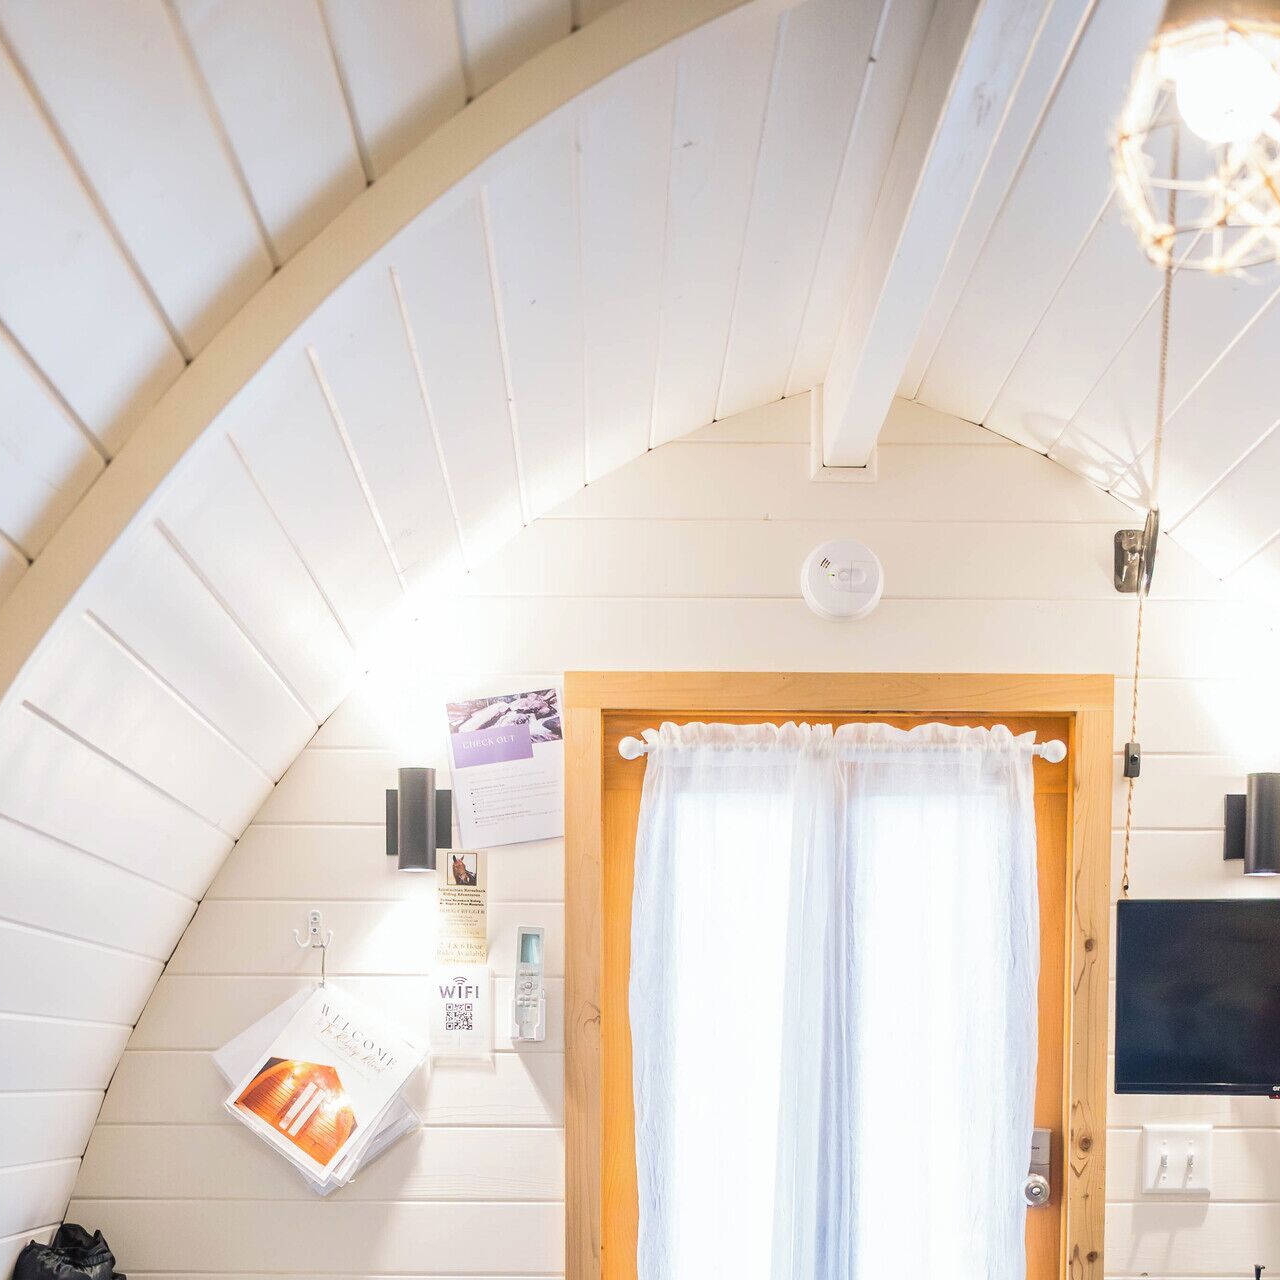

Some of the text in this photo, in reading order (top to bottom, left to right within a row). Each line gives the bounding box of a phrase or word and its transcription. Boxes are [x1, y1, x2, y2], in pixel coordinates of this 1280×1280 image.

[462, 734, 516, 750] CHECK OUT
[439, 985, 479, 999] WIFI
[321, 1003, 398, 1070] WELCOME
